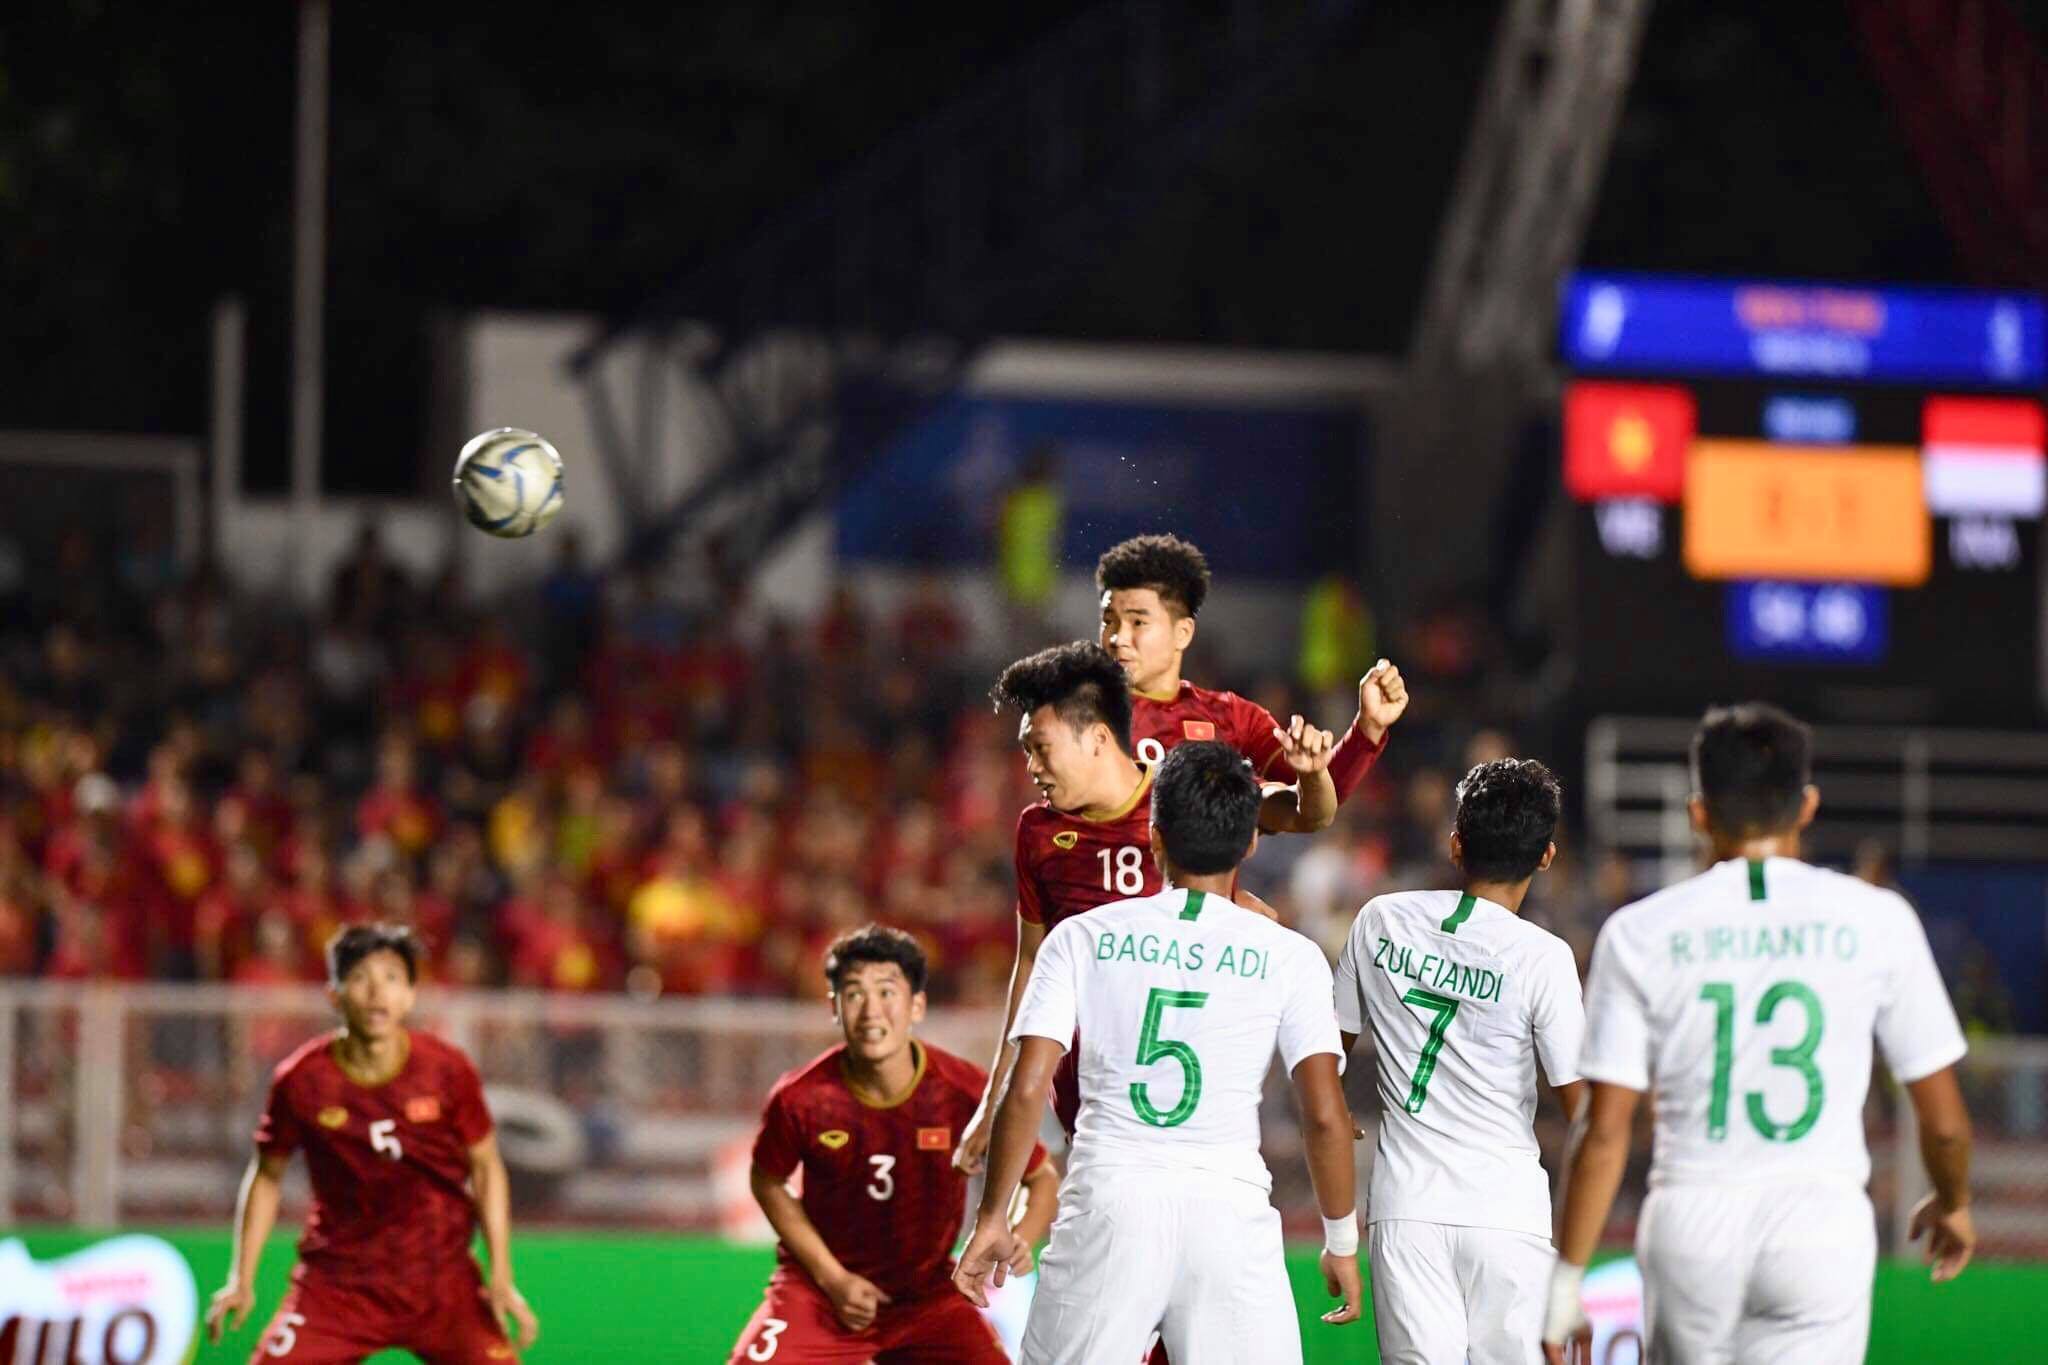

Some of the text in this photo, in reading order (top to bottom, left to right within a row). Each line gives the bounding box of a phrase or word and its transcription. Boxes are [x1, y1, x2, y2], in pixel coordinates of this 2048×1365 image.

[1097, 846, 1144, 896] 18
[1097, 933, 1269, 980] BAGAS ADI
[1374, 937, 1504, 1003] ZULFIANDI
[1128, 986, 1210, 1129] 5
[1401, 986, 1460, 1114] 7
[1696, 979, 1826, 1145] 13
[369, 1118, 402, 1160] 5
[867, 1153, 896, 1201] 3
[266, 1311, 306, 1357] 5
[747, 1317, 788, 1363] 3
